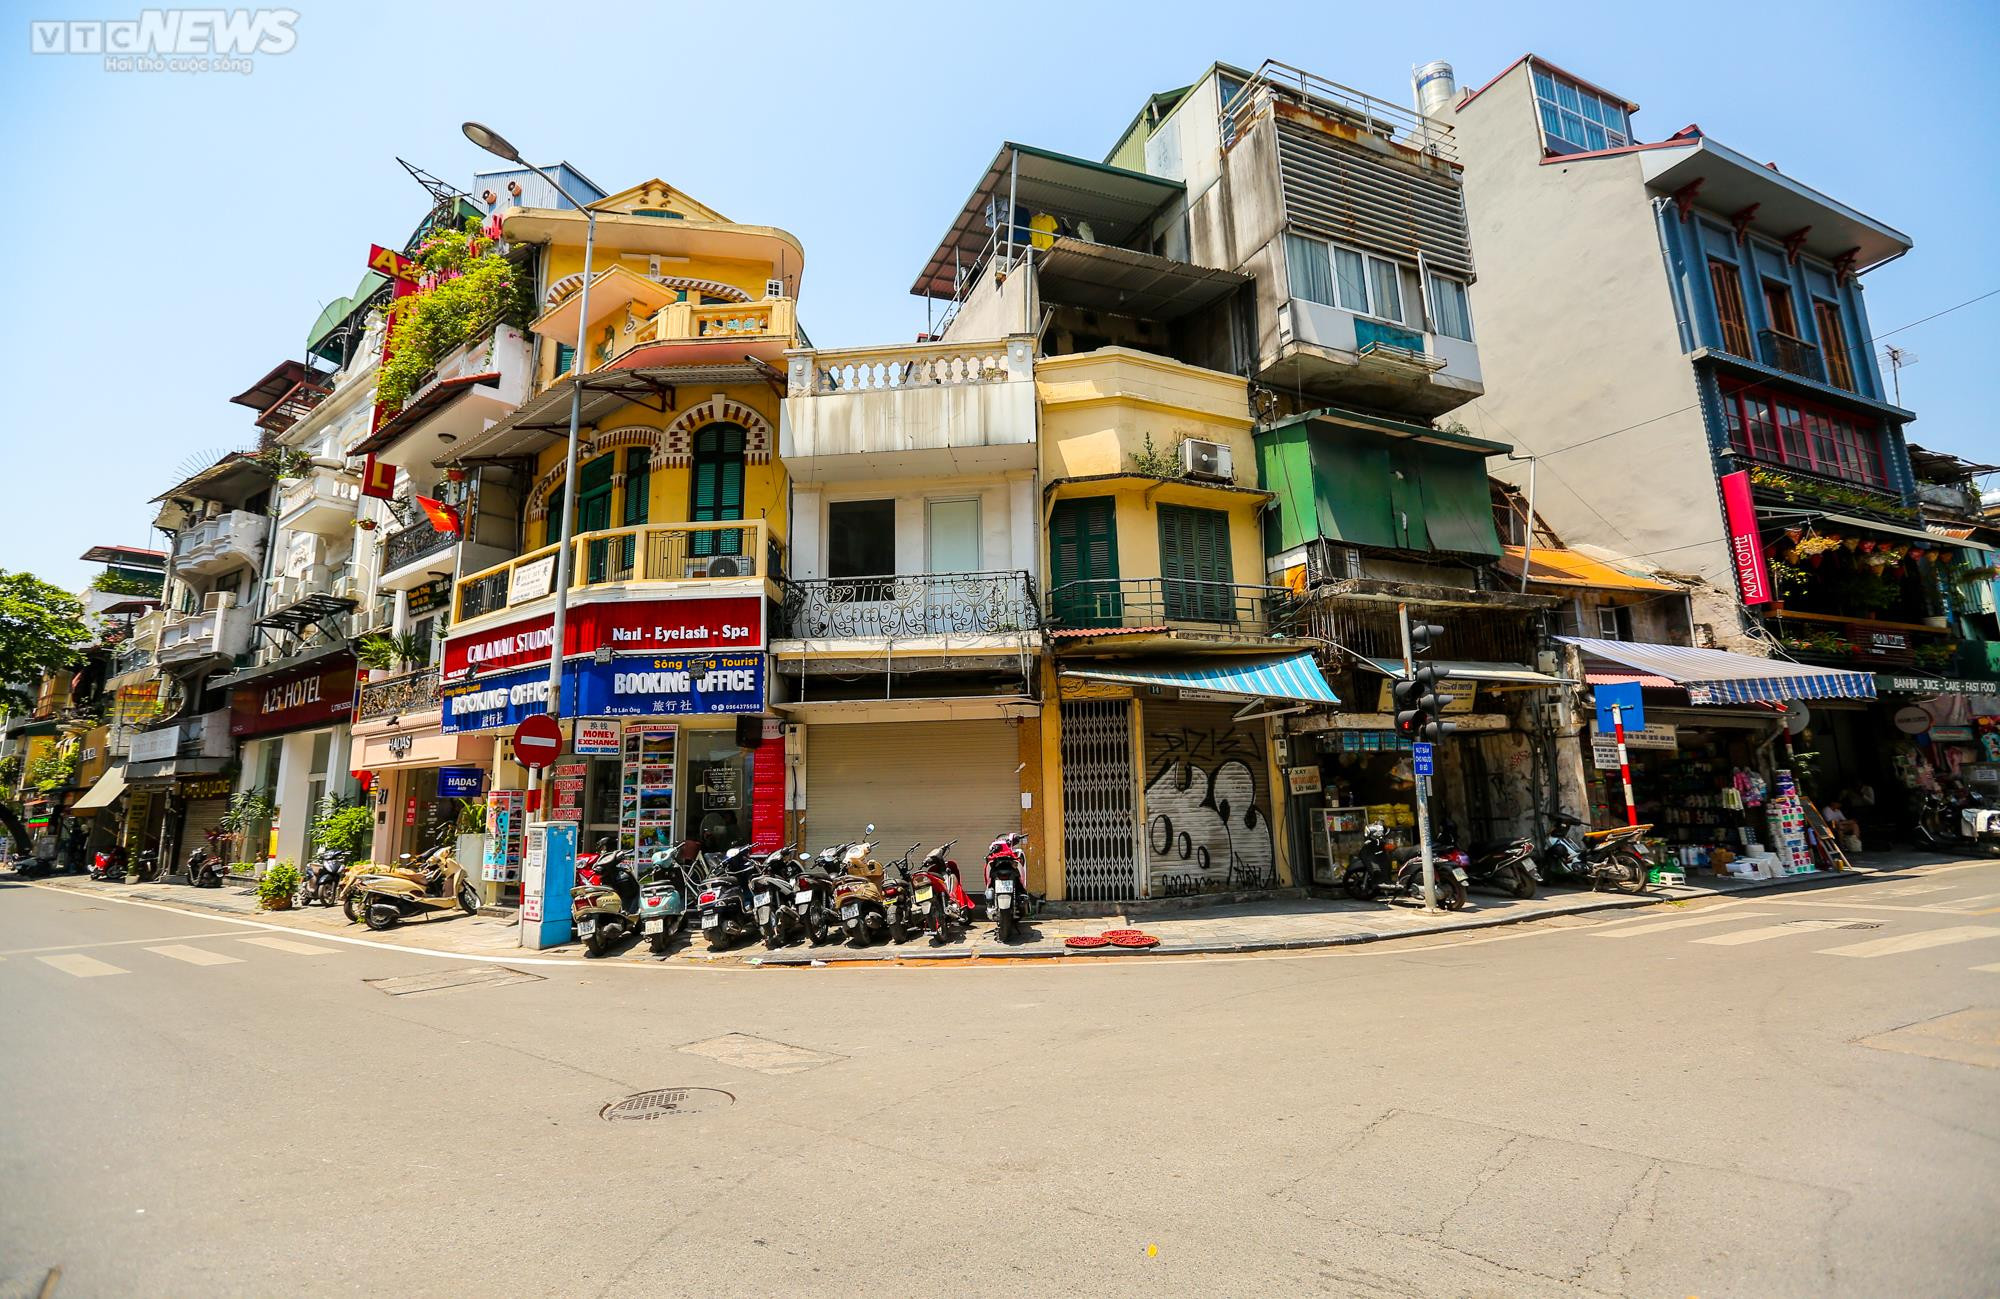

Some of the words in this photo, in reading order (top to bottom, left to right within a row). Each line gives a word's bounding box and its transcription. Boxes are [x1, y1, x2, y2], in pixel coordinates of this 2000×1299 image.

[1739, 567, 1759, 598] AGAIN
[612, 627, 642, 641] Nail
[654, 625, 708, 641] Eyelash
[722, 624, 749, 639] Spa
[654, 659, 683, 670] Sông
[721, 657, 759, 667] Tourist
[614, 670, 690, 695] BOOKING
[1922, 679, 1940, 690] JUICE
[1944, 681, 1961, 691] CAKE
[1965, 681, 1979, 692] FAST
[1981, 682, 1996, 693] FOOD
[262, 686, 283, 714] A25
[284, 675, 321, 709] HOTEL
[451, 687, 509, 716] BOOKING
[652, 699, 693, 712] 旅行社
[583, 730, 615, 738] MONEY
[447, 777, 478, 787] HADAS
